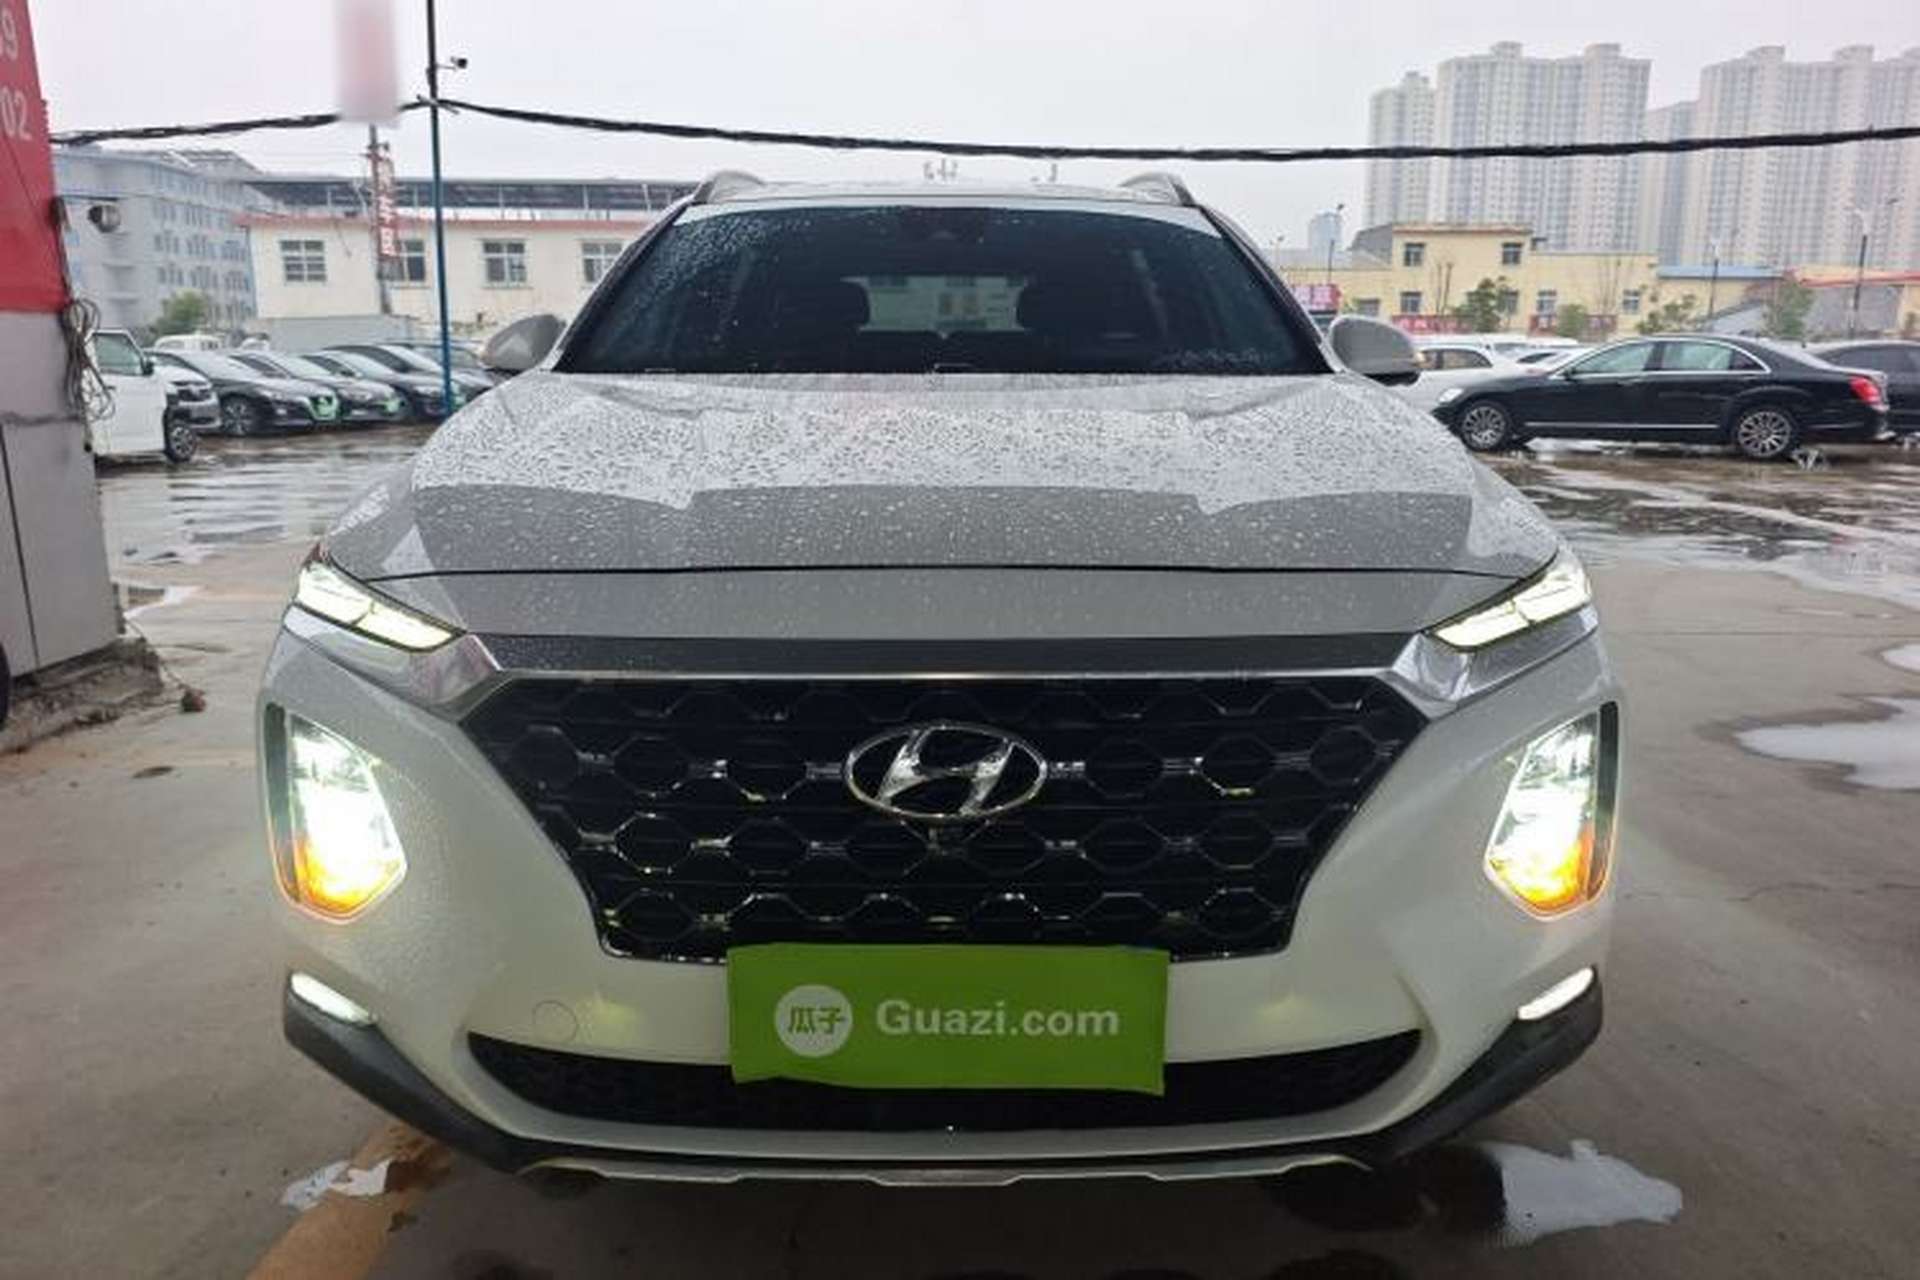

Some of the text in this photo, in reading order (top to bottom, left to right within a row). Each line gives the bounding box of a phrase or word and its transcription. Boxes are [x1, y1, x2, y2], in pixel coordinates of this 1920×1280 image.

[0, 9, 18, 58] 9
[787, 1004, 846, 1035] 瓜子
[876, 1000, 1120, 1037] Guazi.com
